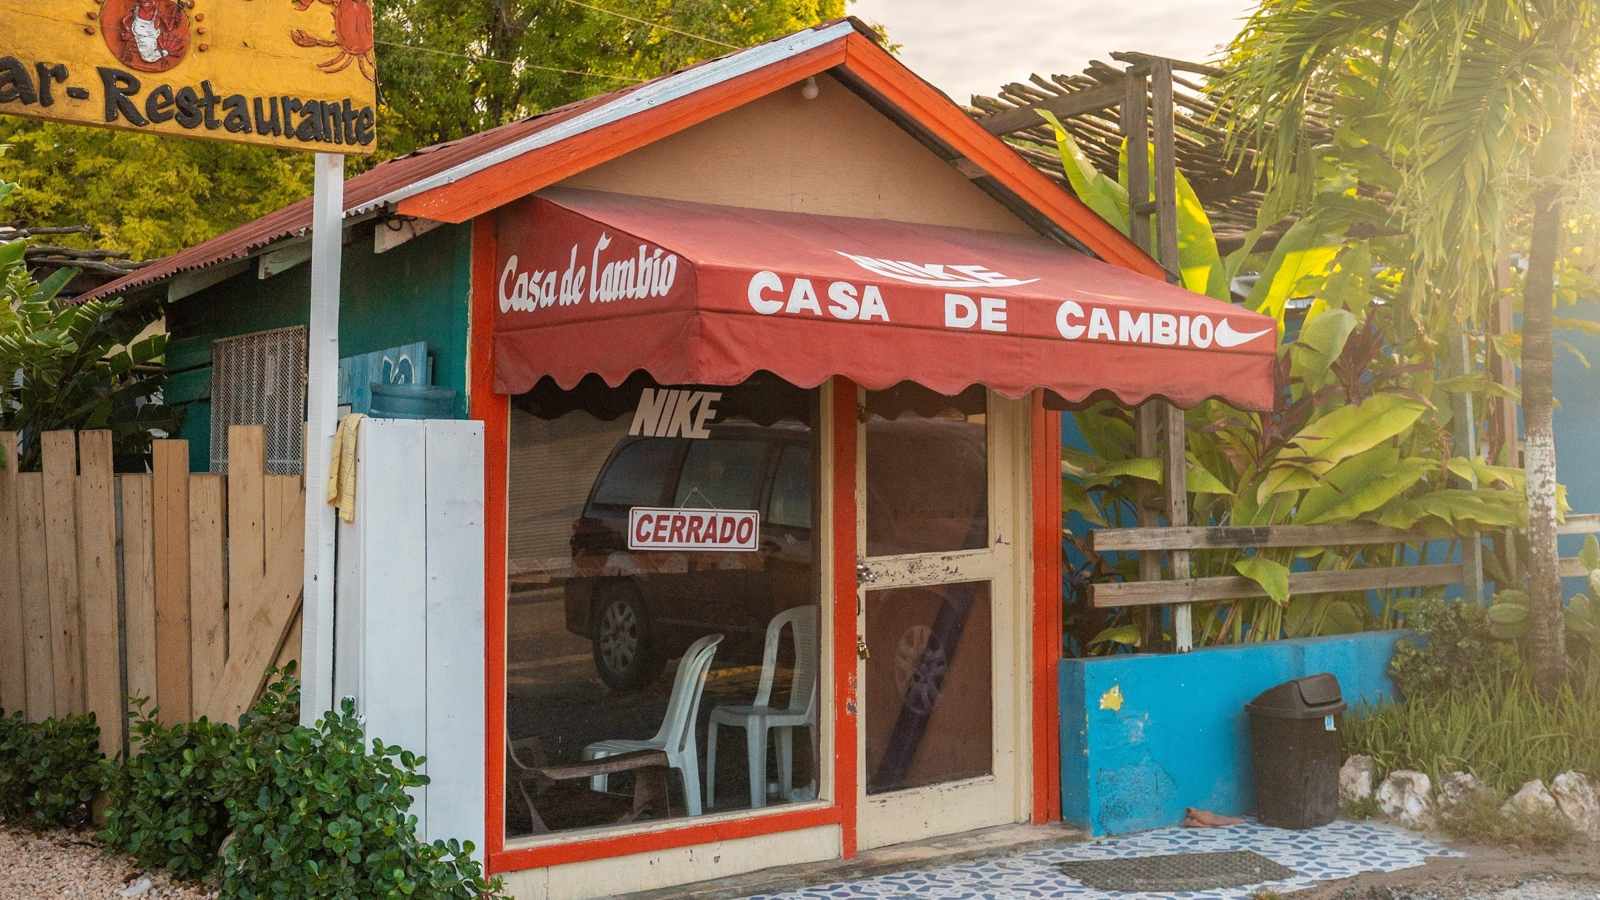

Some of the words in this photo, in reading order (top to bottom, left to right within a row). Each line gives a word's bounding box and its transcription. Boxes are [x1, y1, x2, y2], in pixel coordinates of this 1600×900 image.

[499, 254, 557, 314] Casa
[559, 244, 585, 306] de
[589, 231, 678, 304] Cambio
[748, 270, 890, 322] CASA
[944, 293, 1008, 332] DE
[1056, 300, 1214, 349] CAMBIO
[628, 387, 722, 439] NIKE
[635, 514, 754, 544] CERRADO
